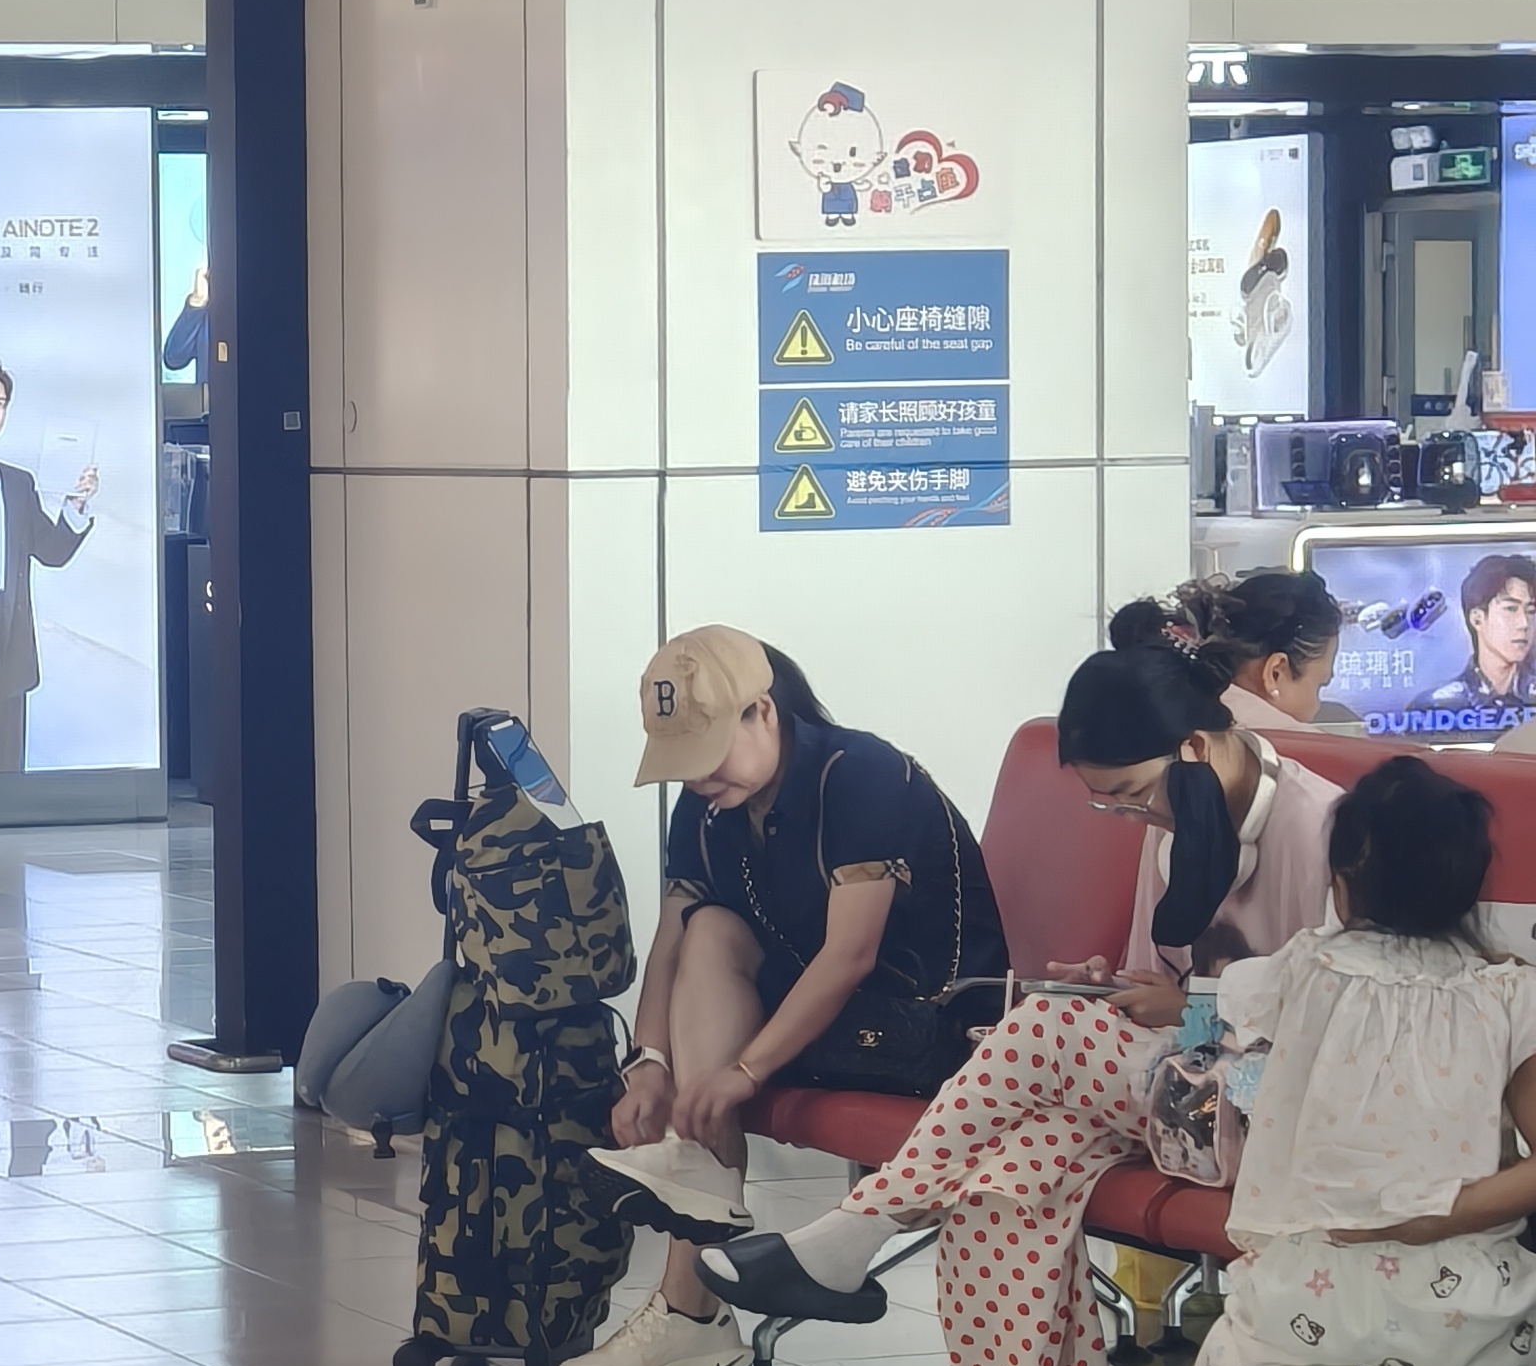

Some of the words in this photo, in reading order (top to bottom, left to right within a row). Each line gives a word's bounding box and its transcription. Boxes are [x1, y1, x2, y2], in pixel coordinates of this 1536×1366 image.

[86, 218, 100, 237] 2
[846, 305, 991, 334] 小心座椅缝隙
[865, 338, 905, 351] careful
[907, 337, 920, 350] of
[922, 337, 941, 350] the
[943, 337, 968, 350] seat
[970, 339, 994, 353] gap
[838, 399, 997, 424] 请家长照顾好孩童
[846, 468, 971, 493] 避免夹伤手脚
[1339, 649, 1415, 676] 琉璃扣
[653, 680, 676, 717] B
